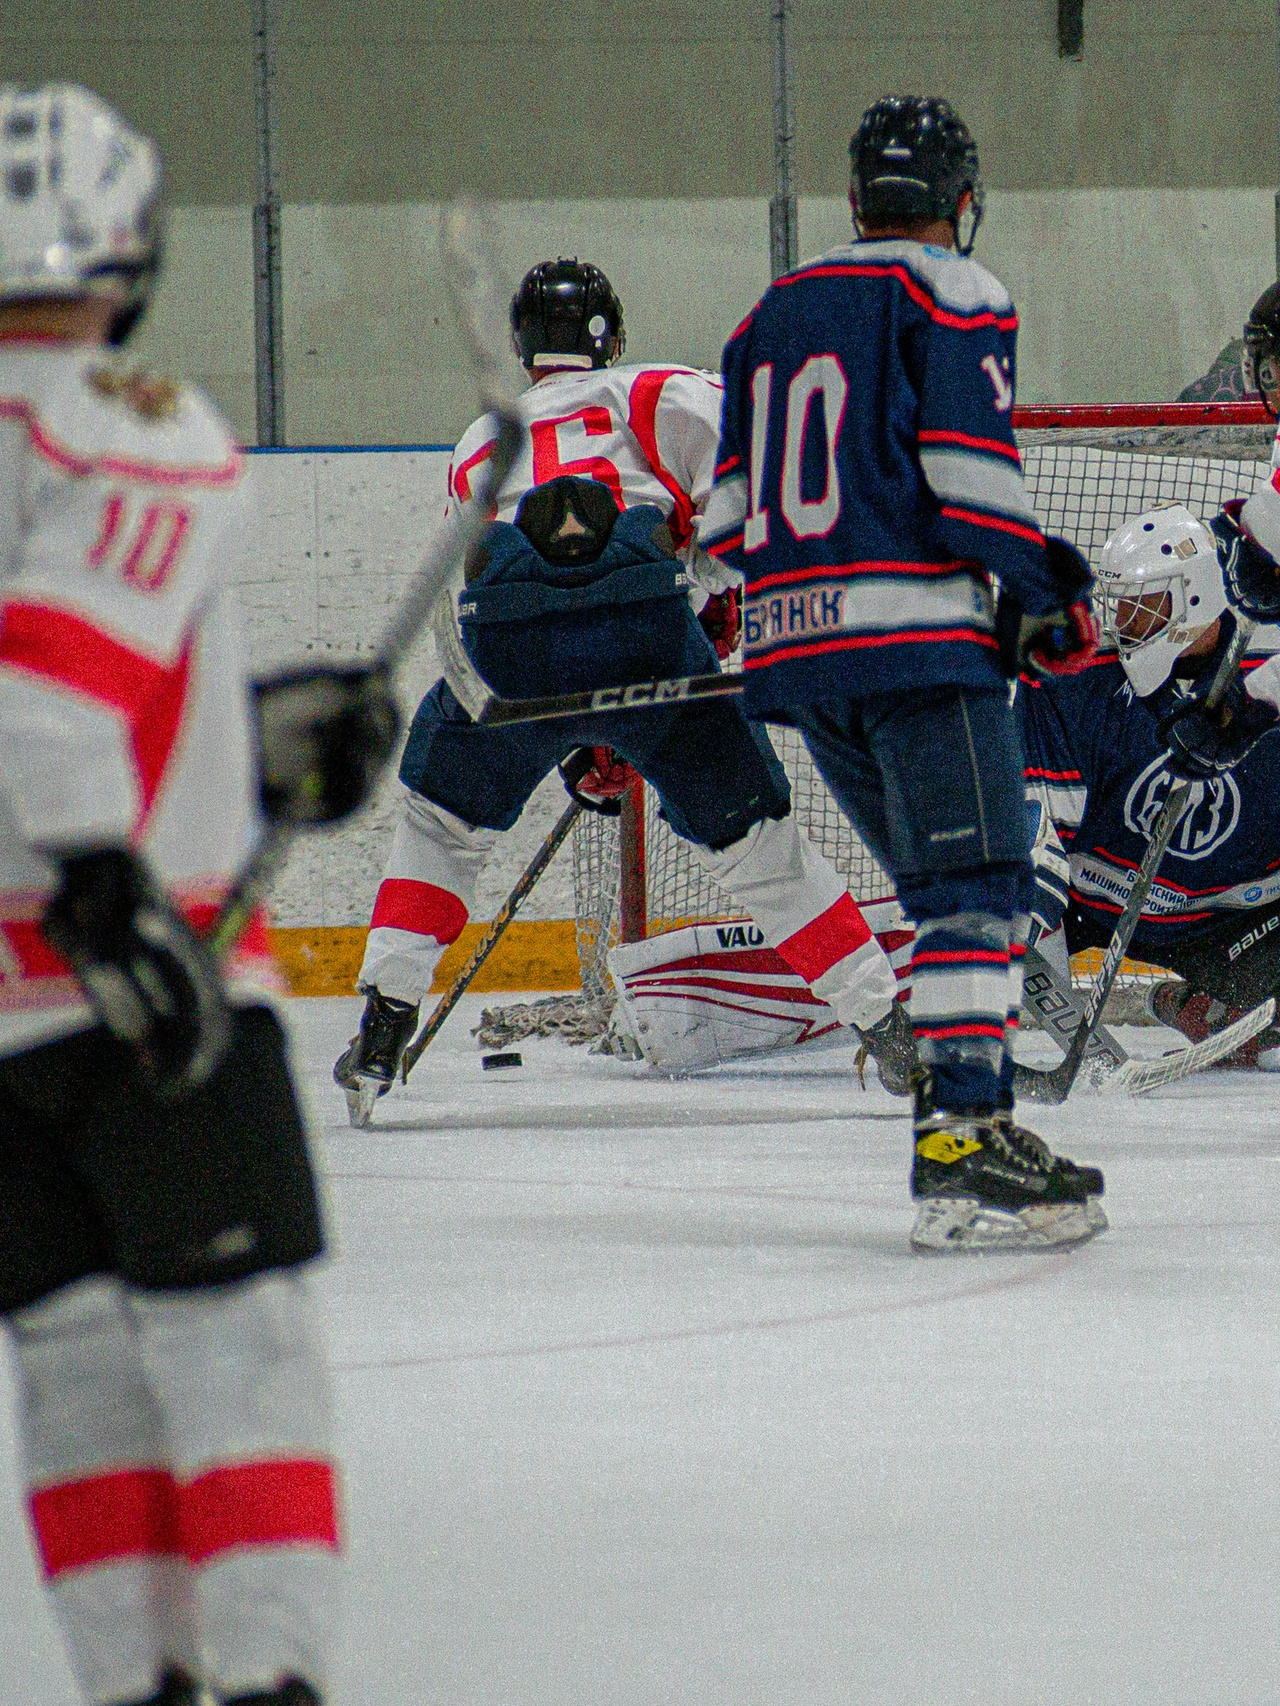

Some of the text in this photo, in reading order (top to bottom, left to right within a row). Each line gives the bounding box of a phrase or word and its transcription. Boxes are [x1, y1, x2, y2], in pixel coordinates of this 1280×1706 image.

[981, 354, 1012, 412] 1
[530, 405, 626, 513] 6
[744, 352, 850, 554] 10
[86, 489, 194, 594] 10
[1098, 569, 1121, 579] CCM
[591, 679, 692, 711] CCM
[1127, 871, 1187, 904] БНСКИЙ
[715, 926, 765, 948] VAU
